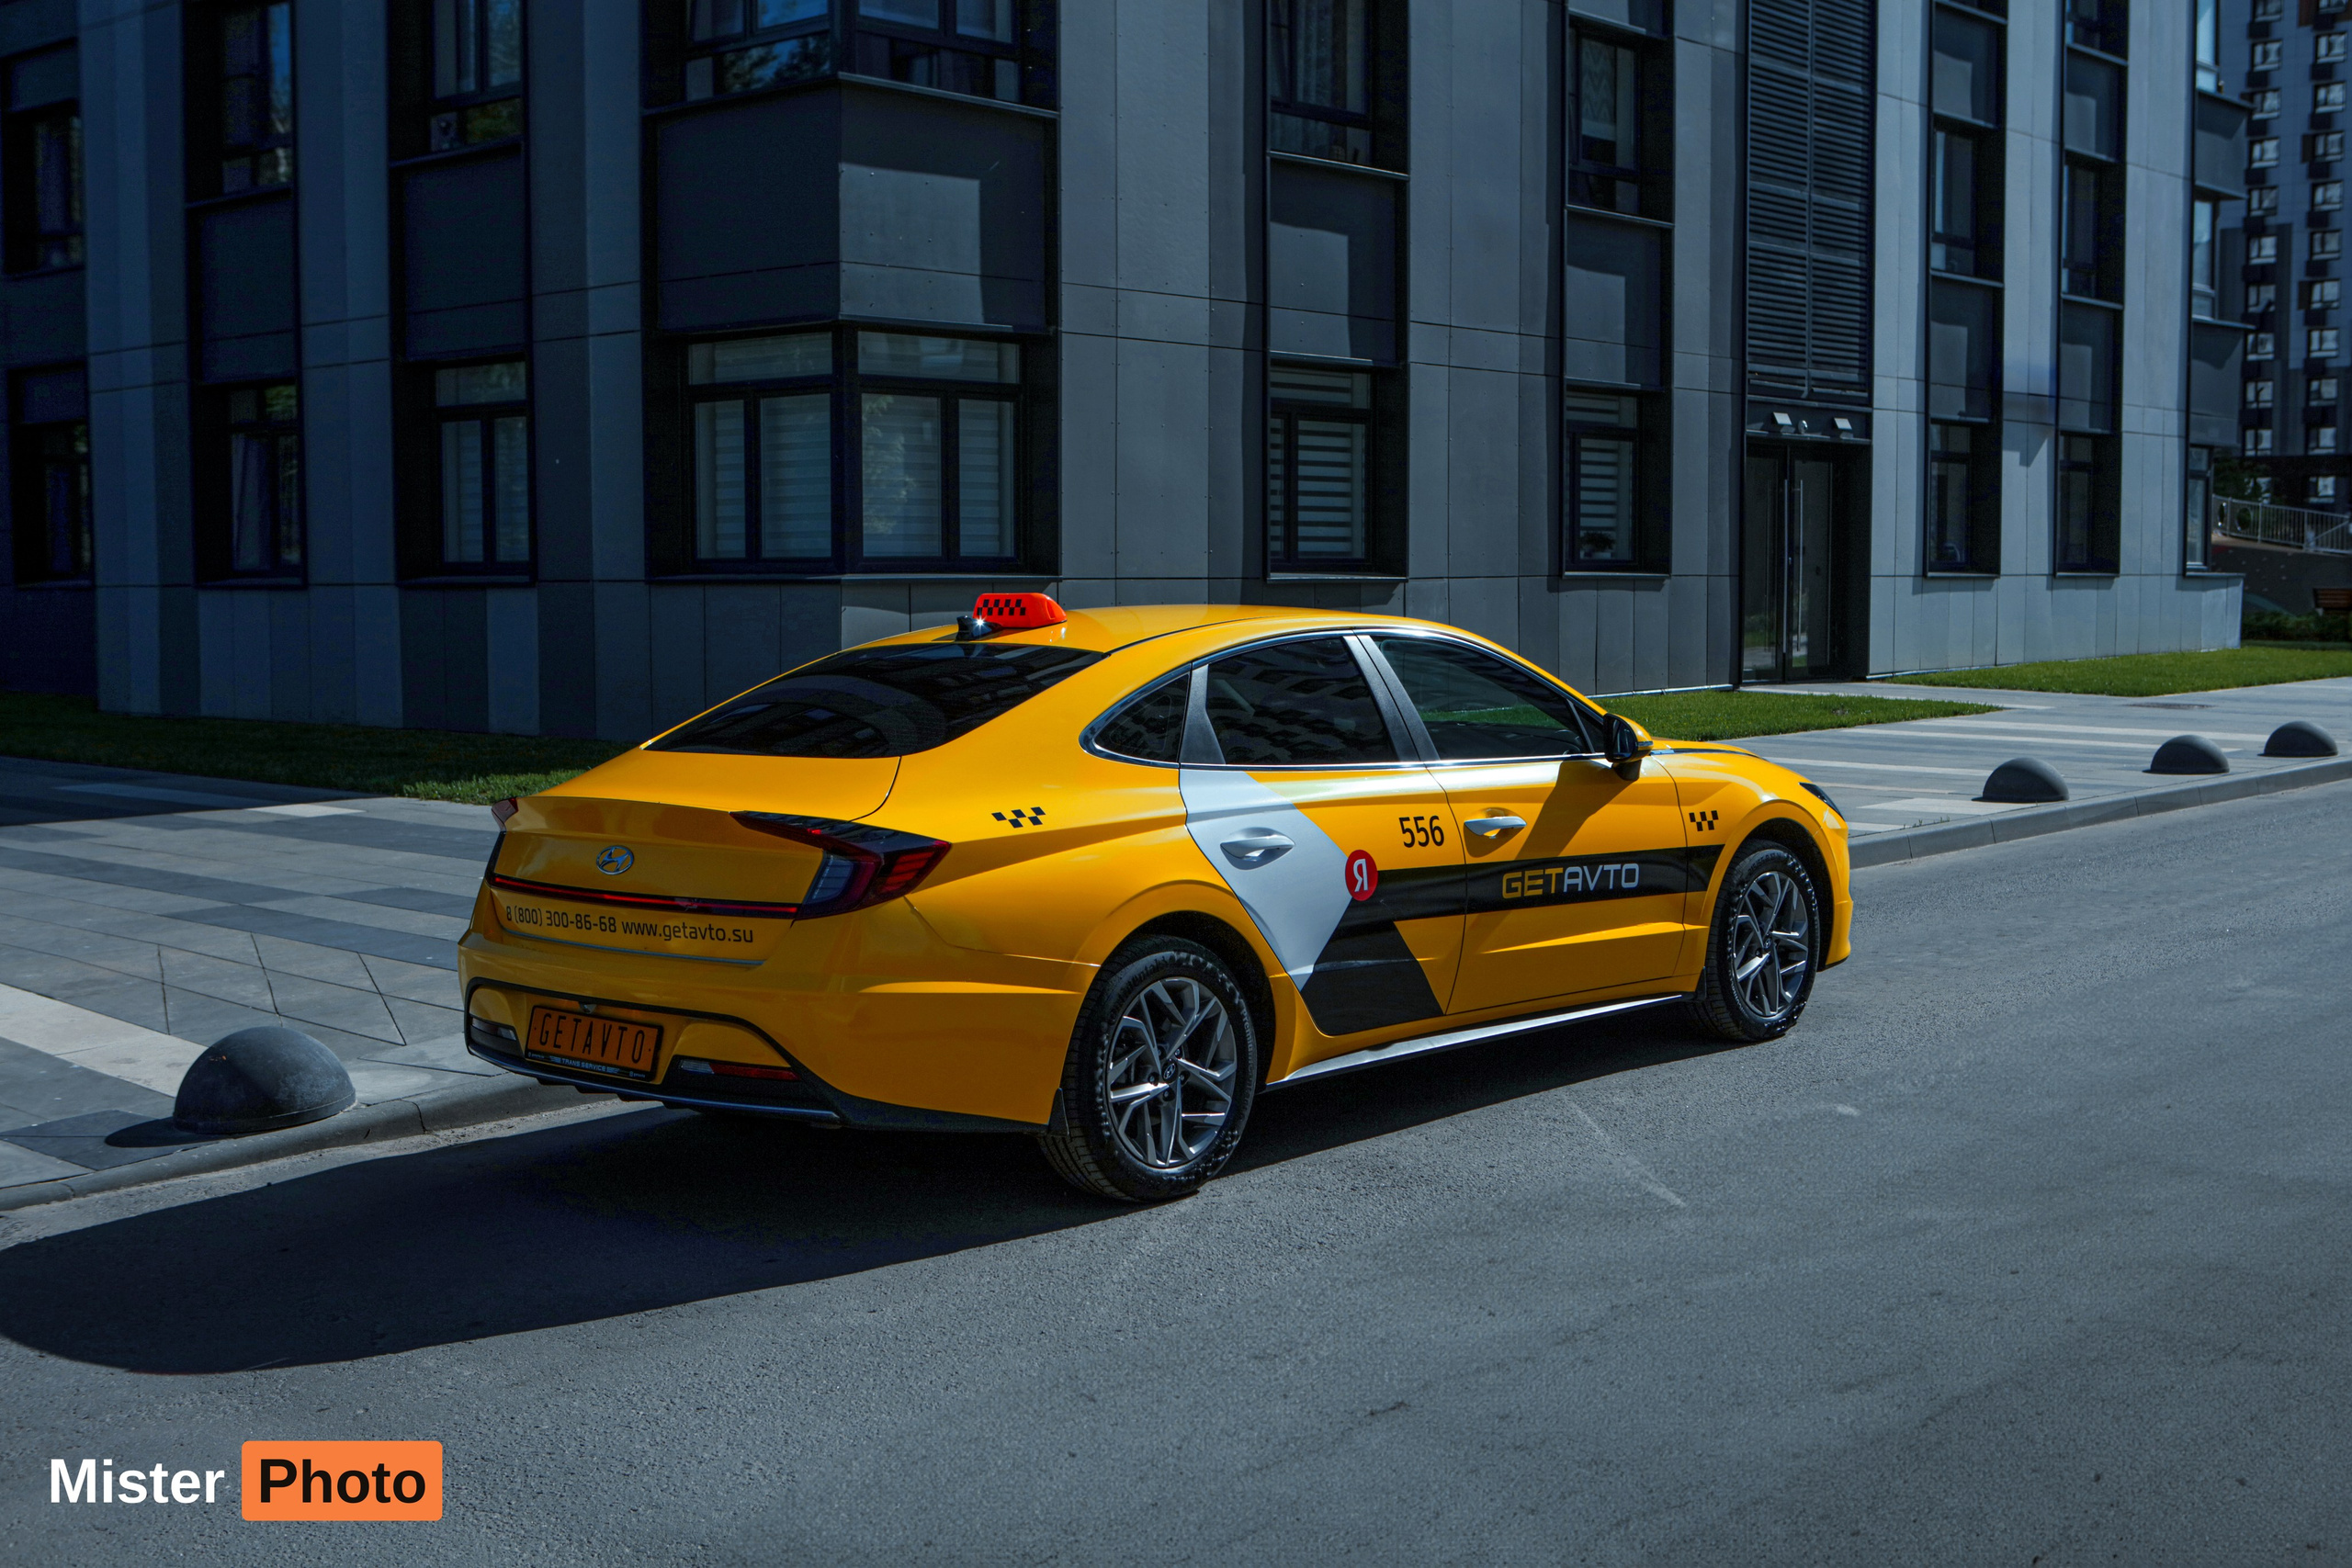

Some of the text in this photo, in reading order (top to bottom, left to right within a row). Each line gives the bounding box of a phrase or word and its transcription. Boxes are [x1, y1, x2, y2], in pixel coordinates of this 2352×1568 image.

[1398, 815, 1445, 849] 556
[1352, 859, 1369, 892] Я
[1501, 863, 1640, 899] GETAVTO
[505, 906, 754, 943] 8 (800) 300-86-68 www.getavto.su
[539, 1013, 645, 1064] GETAVTO
[561, 1057, 606, 1073] TRANS SERVICE
